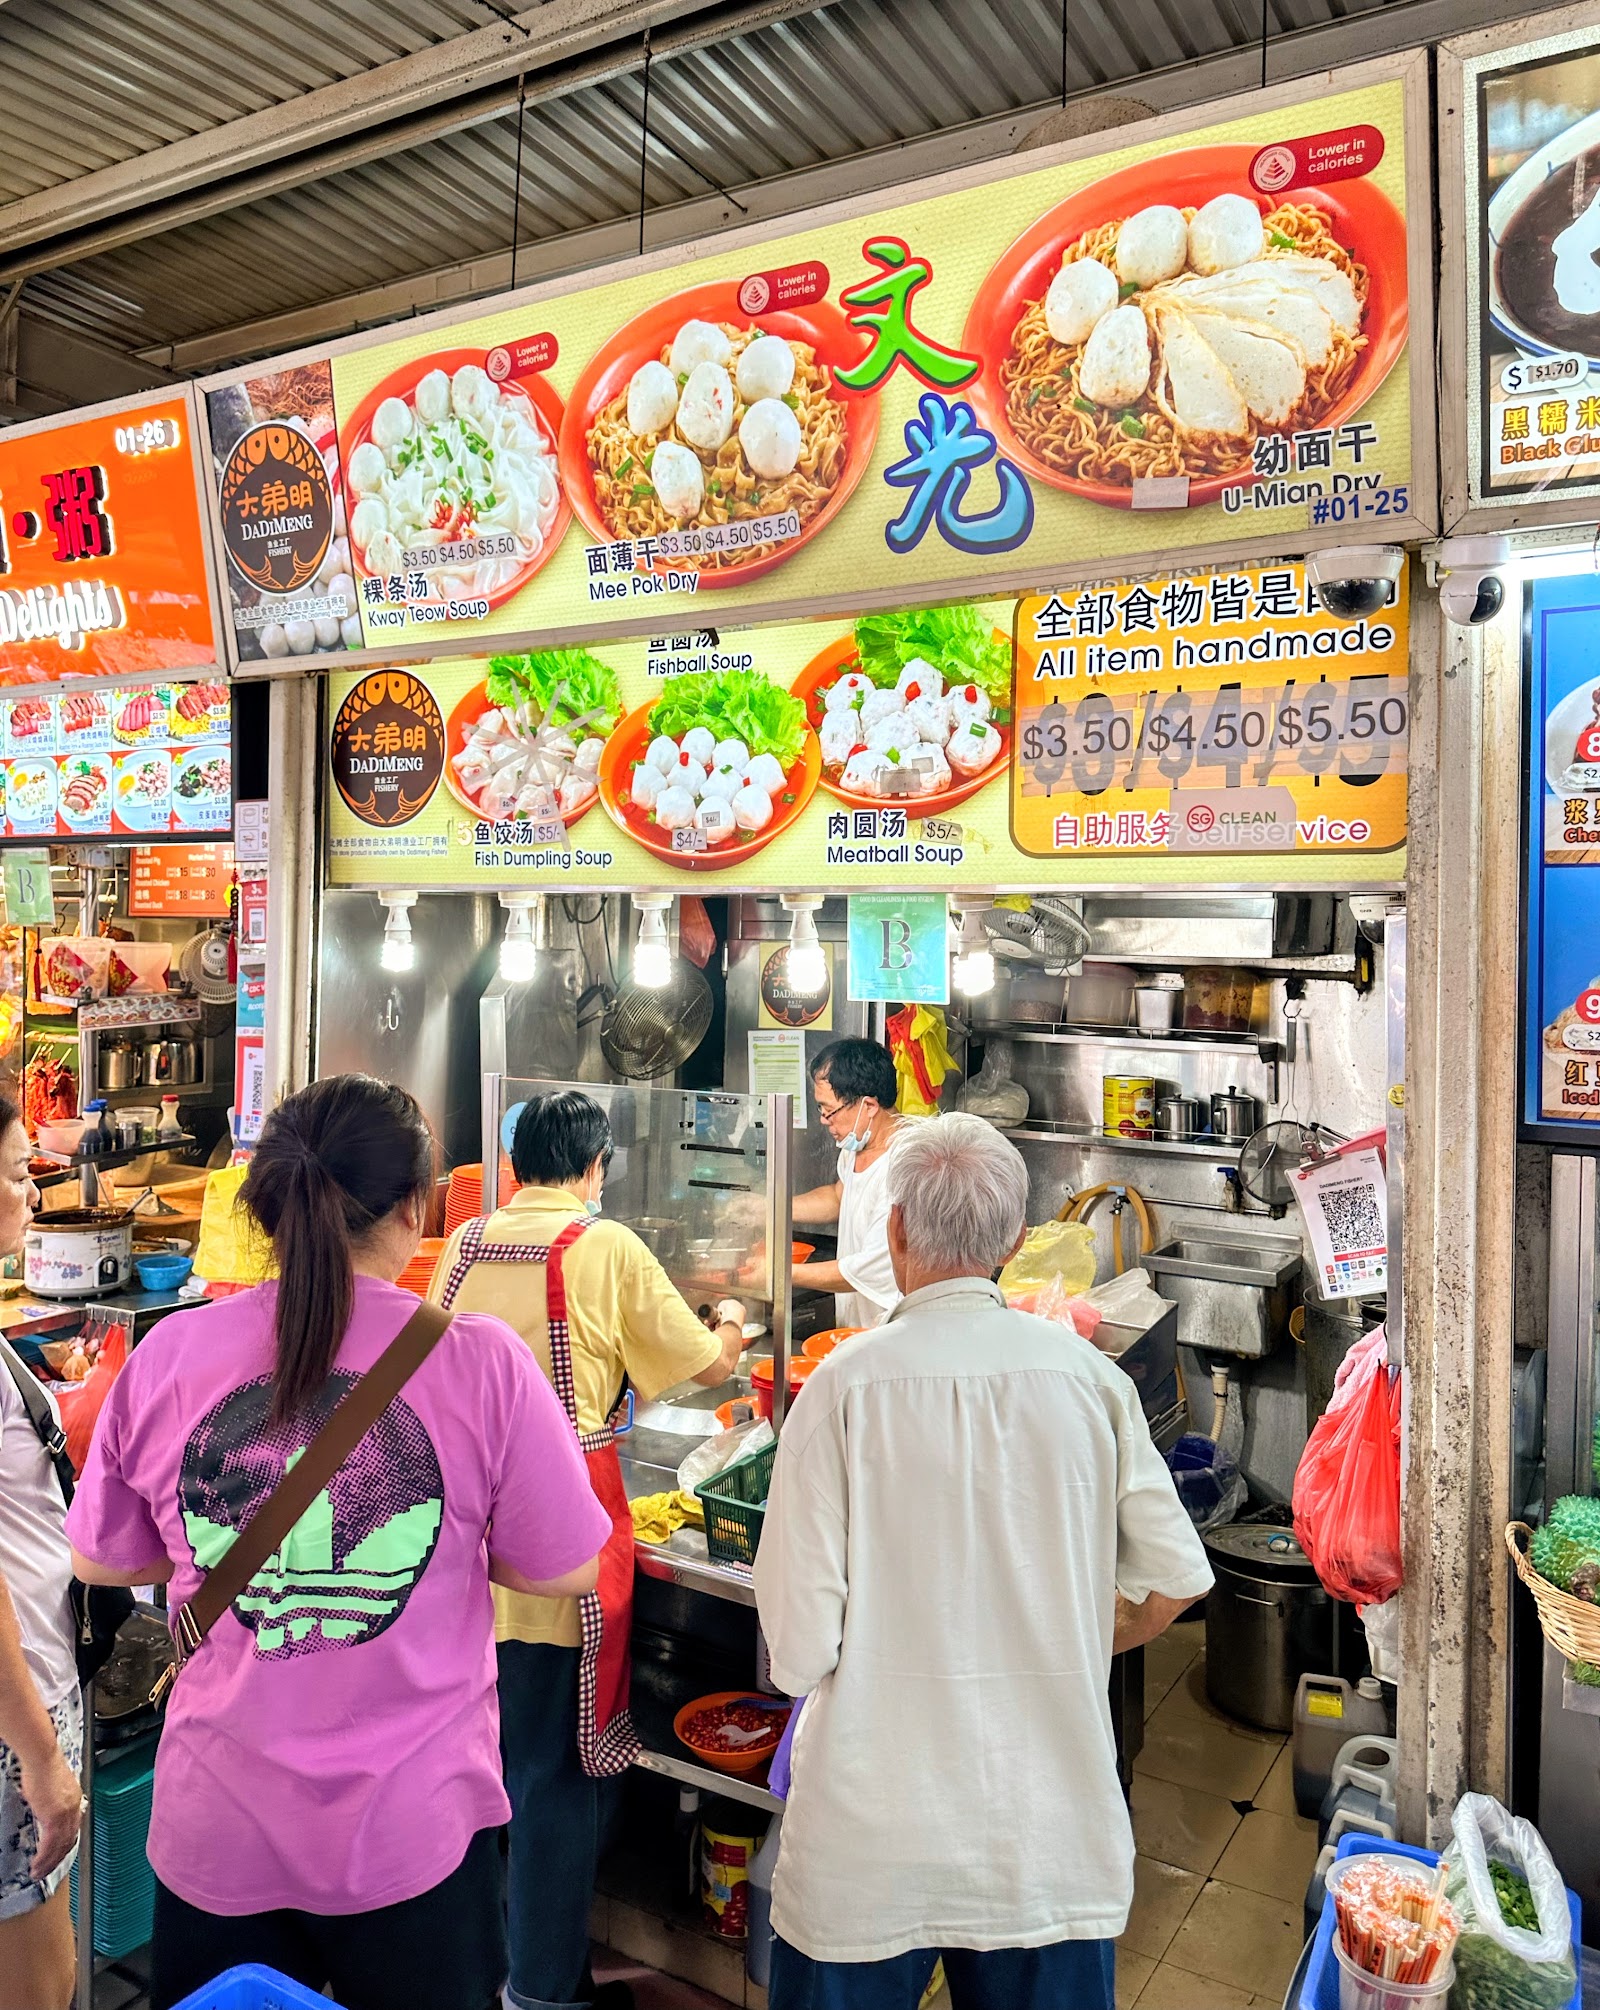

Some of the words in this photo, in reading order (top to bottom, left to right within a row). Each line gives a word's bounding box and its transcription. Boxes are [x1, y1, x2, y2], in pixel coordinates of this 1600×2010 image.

[1308, 142, 1350, 160] Lower
[1353, 138, 1365, 151] in
[1307, 152, 1364, 173] calories
[777, 274, 806, 288] Lower
[808, 271, 817, 281] in
[778, 284, 816, 299] calories
[516, 344, 539, 357] Lower
[541, 341, 548, 350] in
[518, 352, 548, 367] calories
[1536, 362, 1573, 379] $1.70
[830, 236, 1034, 554] 文光
[115, 421, 168, 453] 01-26
[1253, 424, 1377, 475] 幼面干
[1501, 438, 1561, 464] Black
[236, 480, 313, 518] 大弟明
[1224, 482, 1323, 512] U-Mian
[1313, 488, 1409, 525] #01-25
[660, 534, 701, 554] $3.50
[705, 526, 749, 549] $4.50
[752, 515, 797, 541] $5.50
[268, 546, 292, 557] FISHERY
[403, 549, 437, 568] $3.50
[439, 543, 474, 563] $4.50
[478, 537, 514, 556] $5.50
[585, 538, 660, 576] 面薄干
[363, 573, 428, 604] 粿条汤
[589, 582, 627, 600] Mee
[632, 575, 663, 593] Pok
[668, 572, 698, 592] Dry
[368, 609, 405, 627] Kway
[409, 605, 445, 622] Teow
[450, 600, 487, 618] Soup
[1036, 573, 1396, 639] 全部食物皆是
[648, 655, 706, 676] Fishball
[711, 653, 752, 671] Soup
[1036, 647, 1074, 679] All
[1088, 642, 1160, 675] item
[1177, 624, 1392, 667] handmade
[348, 722, 427, 755] 大弟明
[1023, 717, 1131, 760] $3.50
[1148, 711, 1265, 756] $4.50
[1277, 698, 1406, 748] $5.50
[374, 783, 399, 792] FISHERY
[828, 810, 905, 840] 肉圆汤
[926, 821, 958, 840] $5/-
[1054, 812, 1180, 848] 自助服务
[1190, 812, 1211, 825] SG
[1219, 811, 1277, 825] CLEAN
[474, 821, 533, 845] 鱼饺汤
[538, 826, 561, 841] $5/-
[676, 831, 703, 847] $4/-
[475, 851, 499, 866] Fish
[504, 850, 571, 869] Dumpling
[575, 850, 612, 868] Soup
[827, 845, 909, 864] Meatball
[914, 845, 964, 865] Soup
[17, 868, 35, 904] B
[879, 919, 912, 969] B
[1562, 1089, 1600, 1105] Iced
[1320, 1180, 1344, 1189] DADIMENG
[1344, 1177, 1363, 1186] FISHERY
